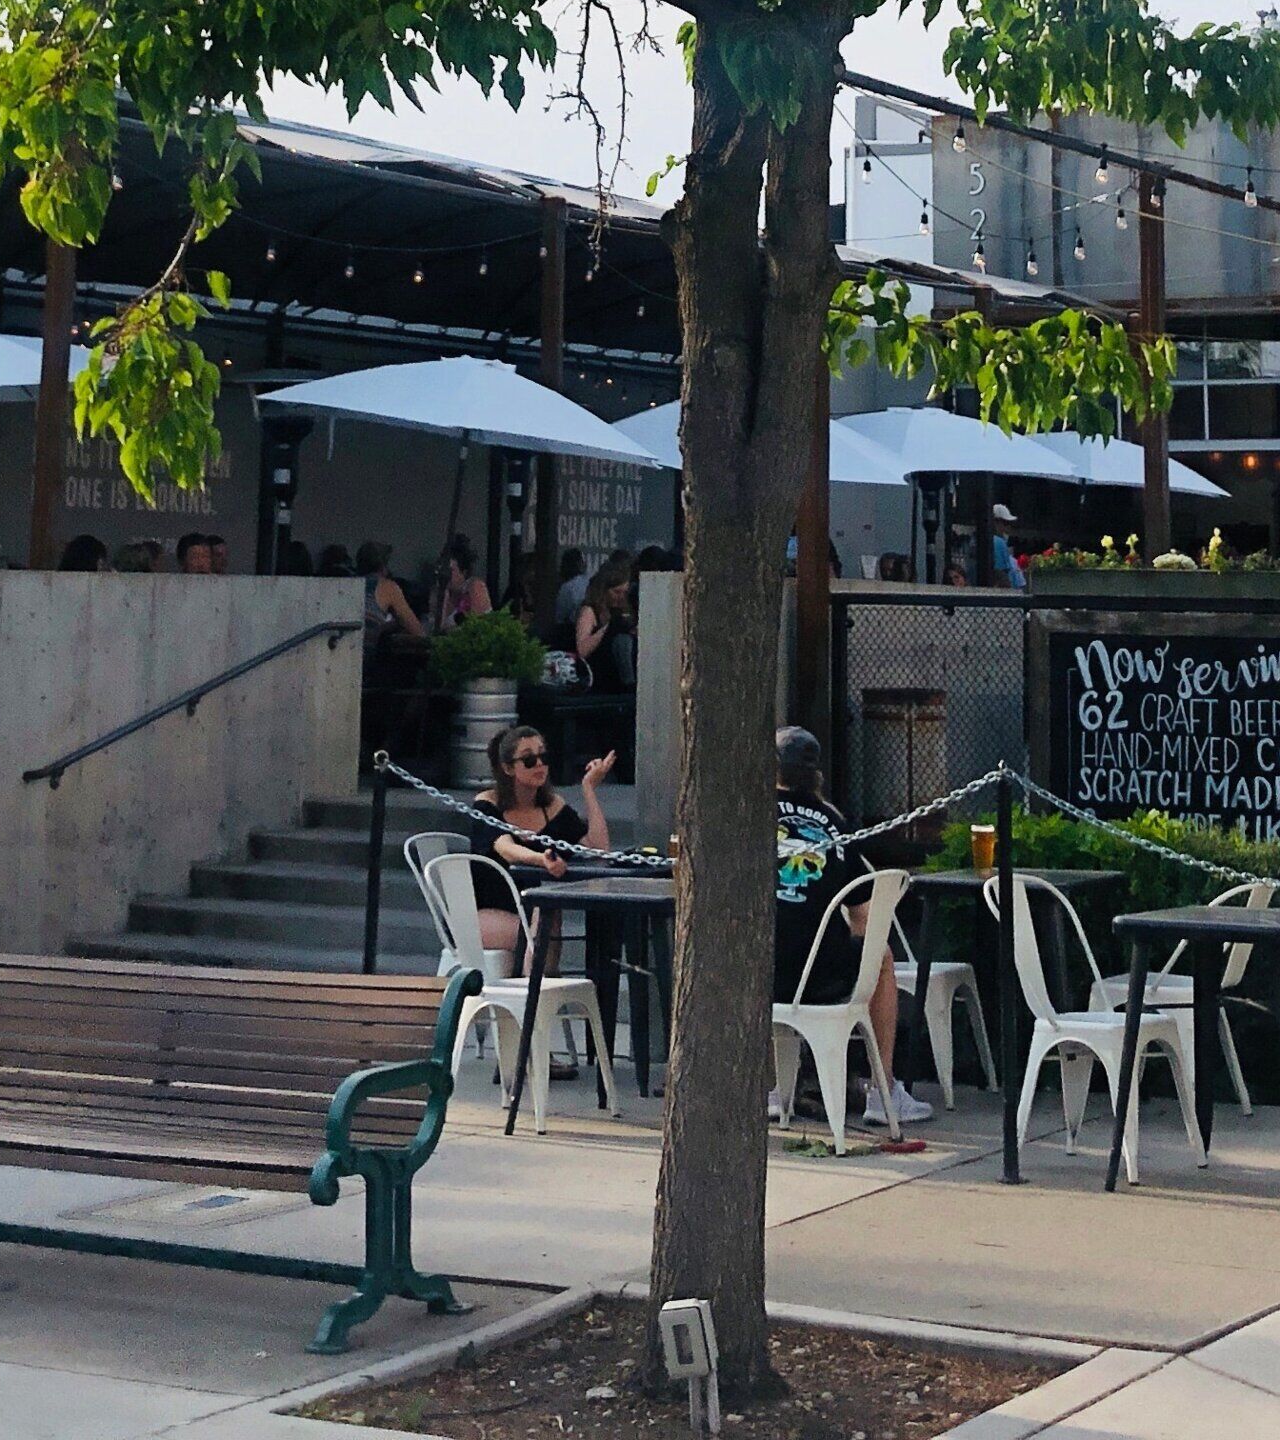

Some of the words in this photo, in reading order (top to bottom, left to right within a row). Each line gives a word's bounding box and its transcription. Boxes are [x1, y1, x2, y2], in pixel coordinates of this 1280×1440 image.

[66, 476, 103, 508] ONE
[568, 480, 610, 513] SOME
[615, 484, 643, 515] DAY
[557, 514, 619, 549] CHANCE
[1075, 639, 1170, 692] Now
[1078, 689, 1129, 730] 62
[1140, 693, 1220, 735] CRAFT
[1081, 732, 1241, 774] HAND-MIXED
[1078, 766, 1193, 806] SCRATCH
